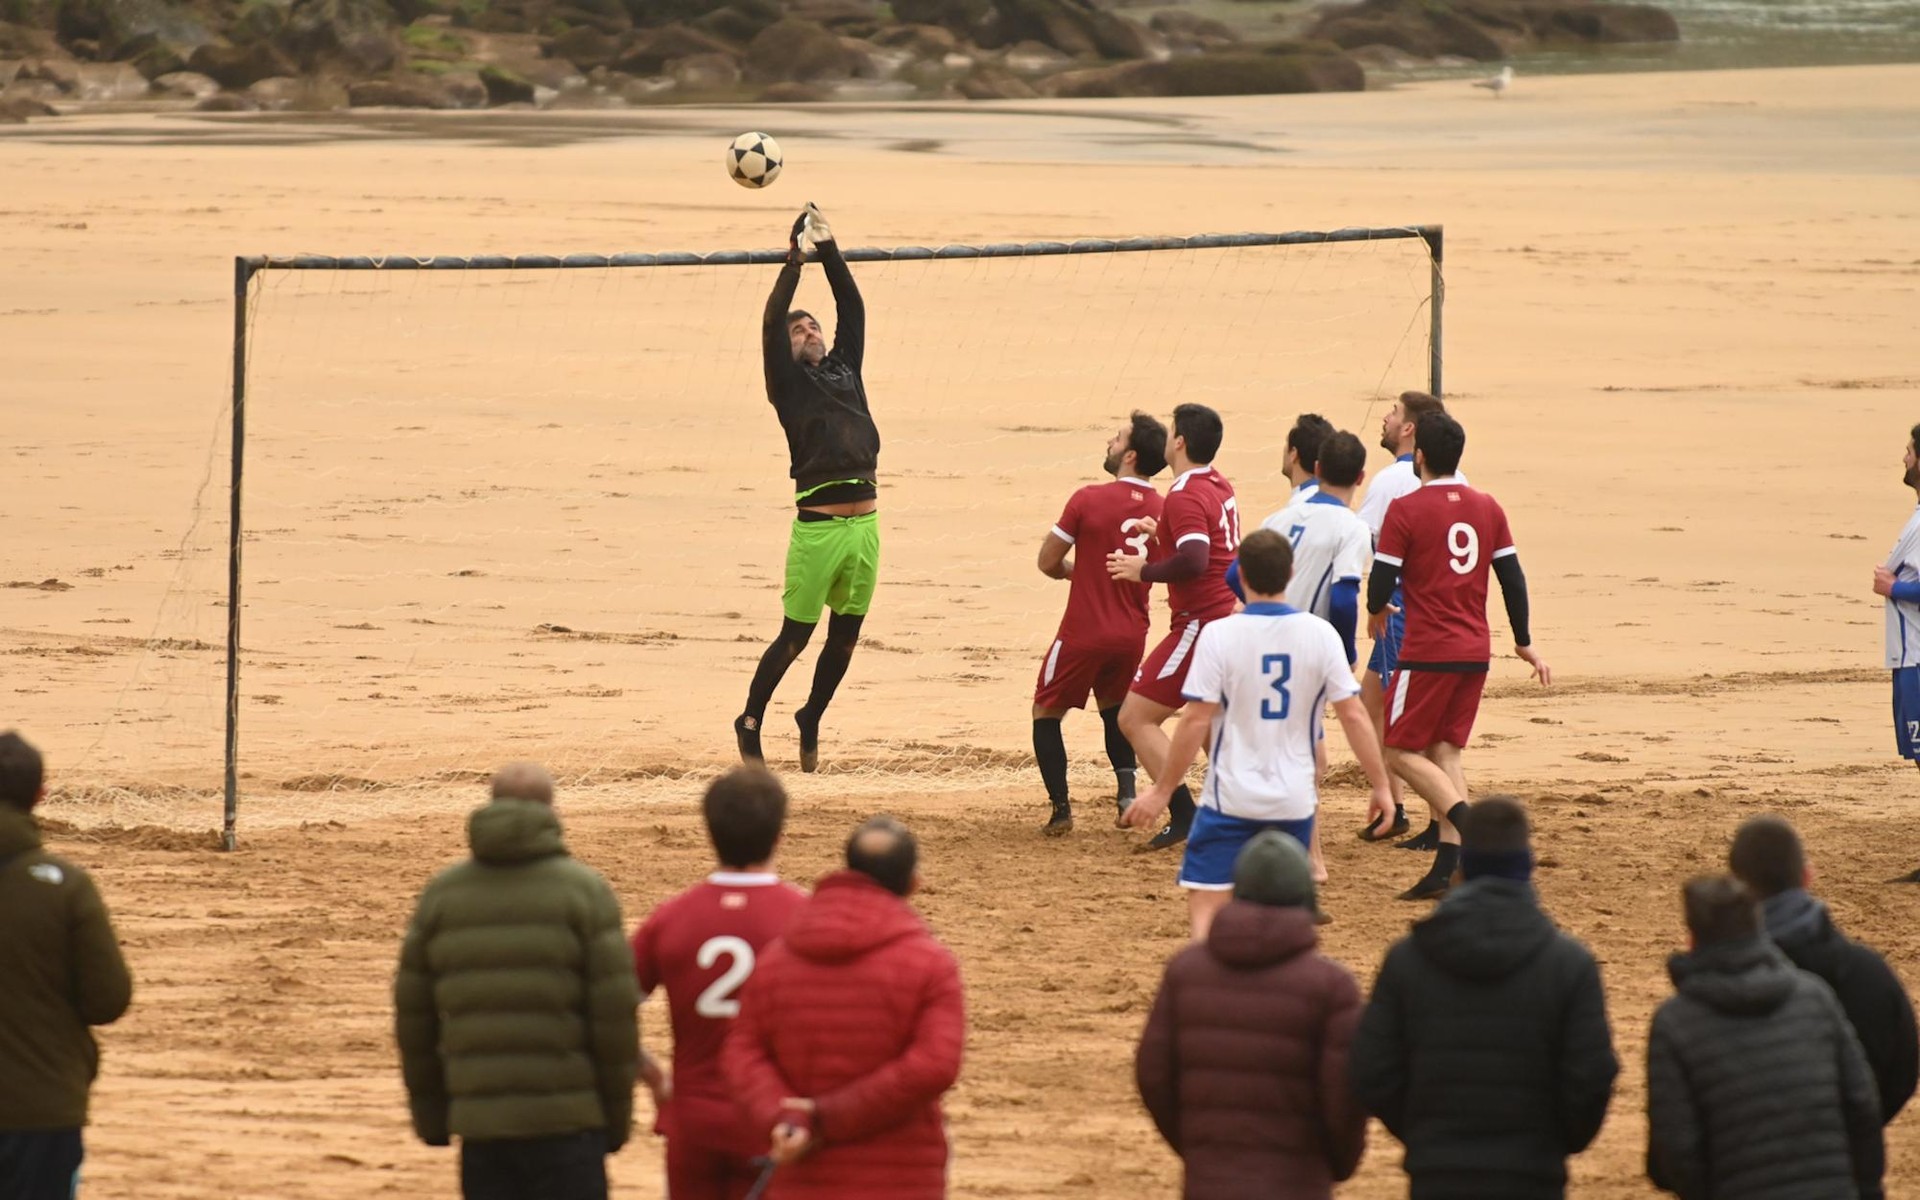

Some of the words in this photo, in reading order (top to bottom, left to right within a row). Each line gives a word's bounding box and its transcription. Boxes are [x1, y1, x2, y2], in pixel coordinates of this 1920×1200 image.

[1115, 518, 1150, 562] 3
[1288, 525, 1305, 551] 7
[1448, 522, 1479, 575] 9
[1261, 654, 1291, 719] 3
[697, 935, 755, 1017] 2
